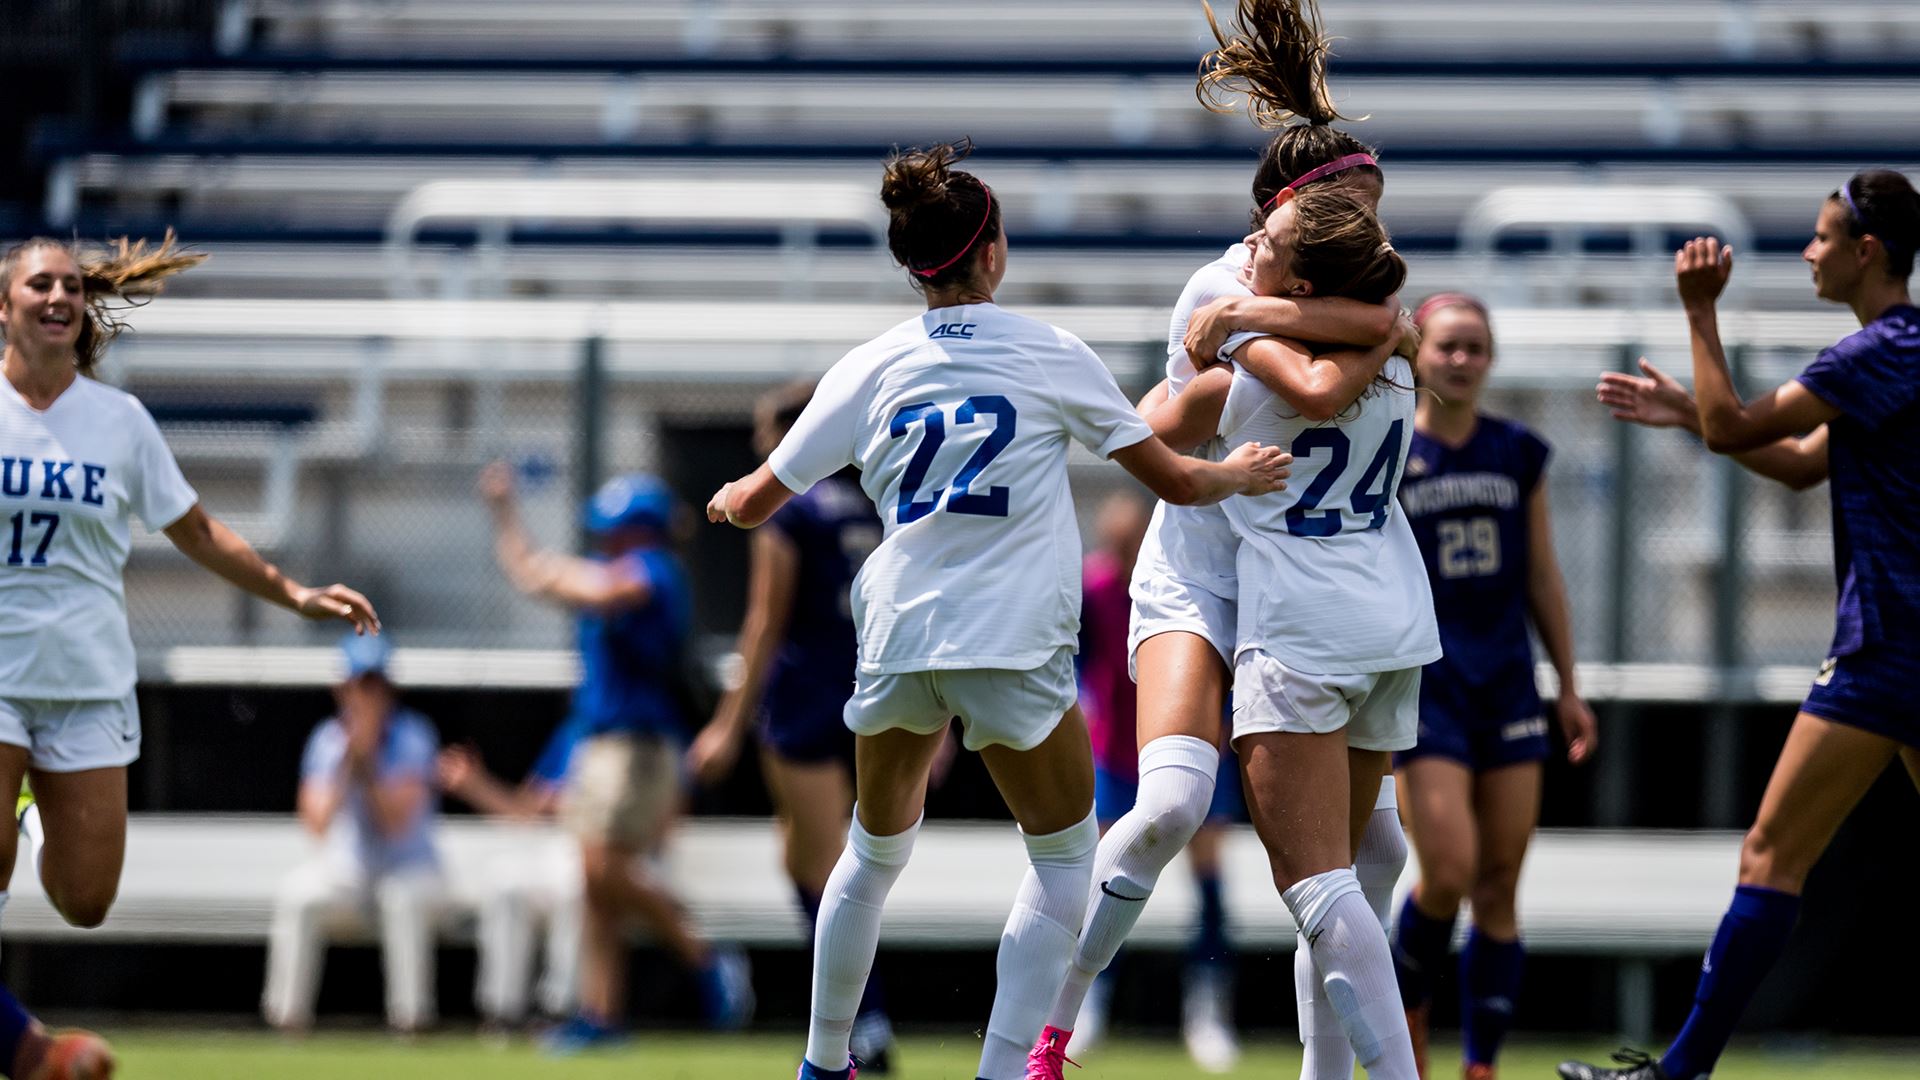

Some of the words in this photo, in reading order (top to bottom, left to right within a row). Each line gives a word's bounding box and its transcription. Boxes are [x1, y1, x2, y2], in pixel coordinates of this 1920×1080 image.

[929, 323, 977, 340] ACC
[890, 395, 1017, 524] 22
[1285, 418, 1404, 537] 24
[7, 509, 60, 567] 17
[1438, 517, 1501, 579] 29
